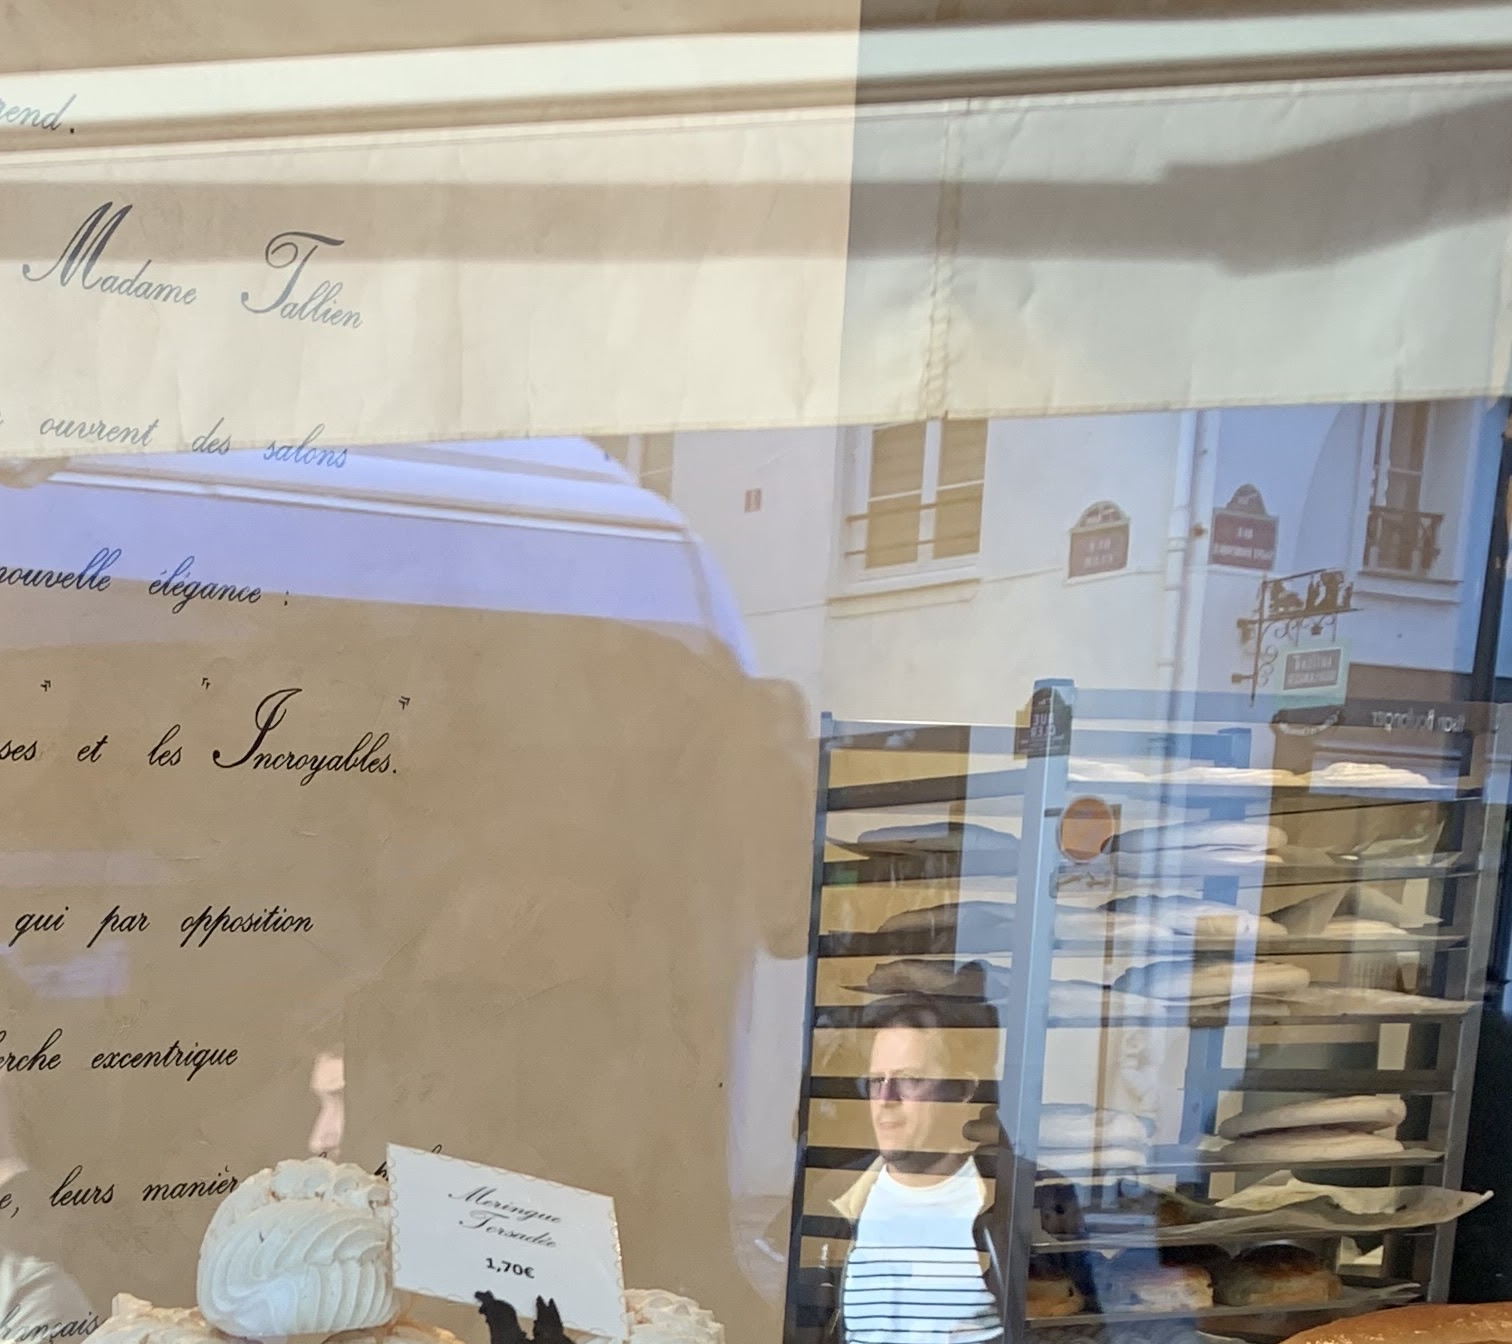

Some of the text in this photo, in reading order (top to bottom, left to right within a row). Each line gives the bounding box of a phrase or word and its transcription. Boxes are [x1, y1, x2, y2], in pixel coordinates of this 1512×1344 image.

[22, 200, 198, 306] Madame
[240, 230, 364, 330] Tallien
[39, 417, 160, 448] ouvrent
[192, 417, 231, 457] des
[263, 422, 348, 469] salons
[77, 735, 110, 764] et
[148, 724, 183, 767] les
[8, 906, 70, 947] qui
[87, 905, 151, 948] par
[180, 905, 315, 948] opposition
[91, 1039, 240, 1082] excentrique
[48, 1164, 115, 1207] leurs
[141, 1165, 240, 1202] manièr
[448, 1186, 562, 1224] Meringue
[485, 1257, 536, 1280] 1,70€
